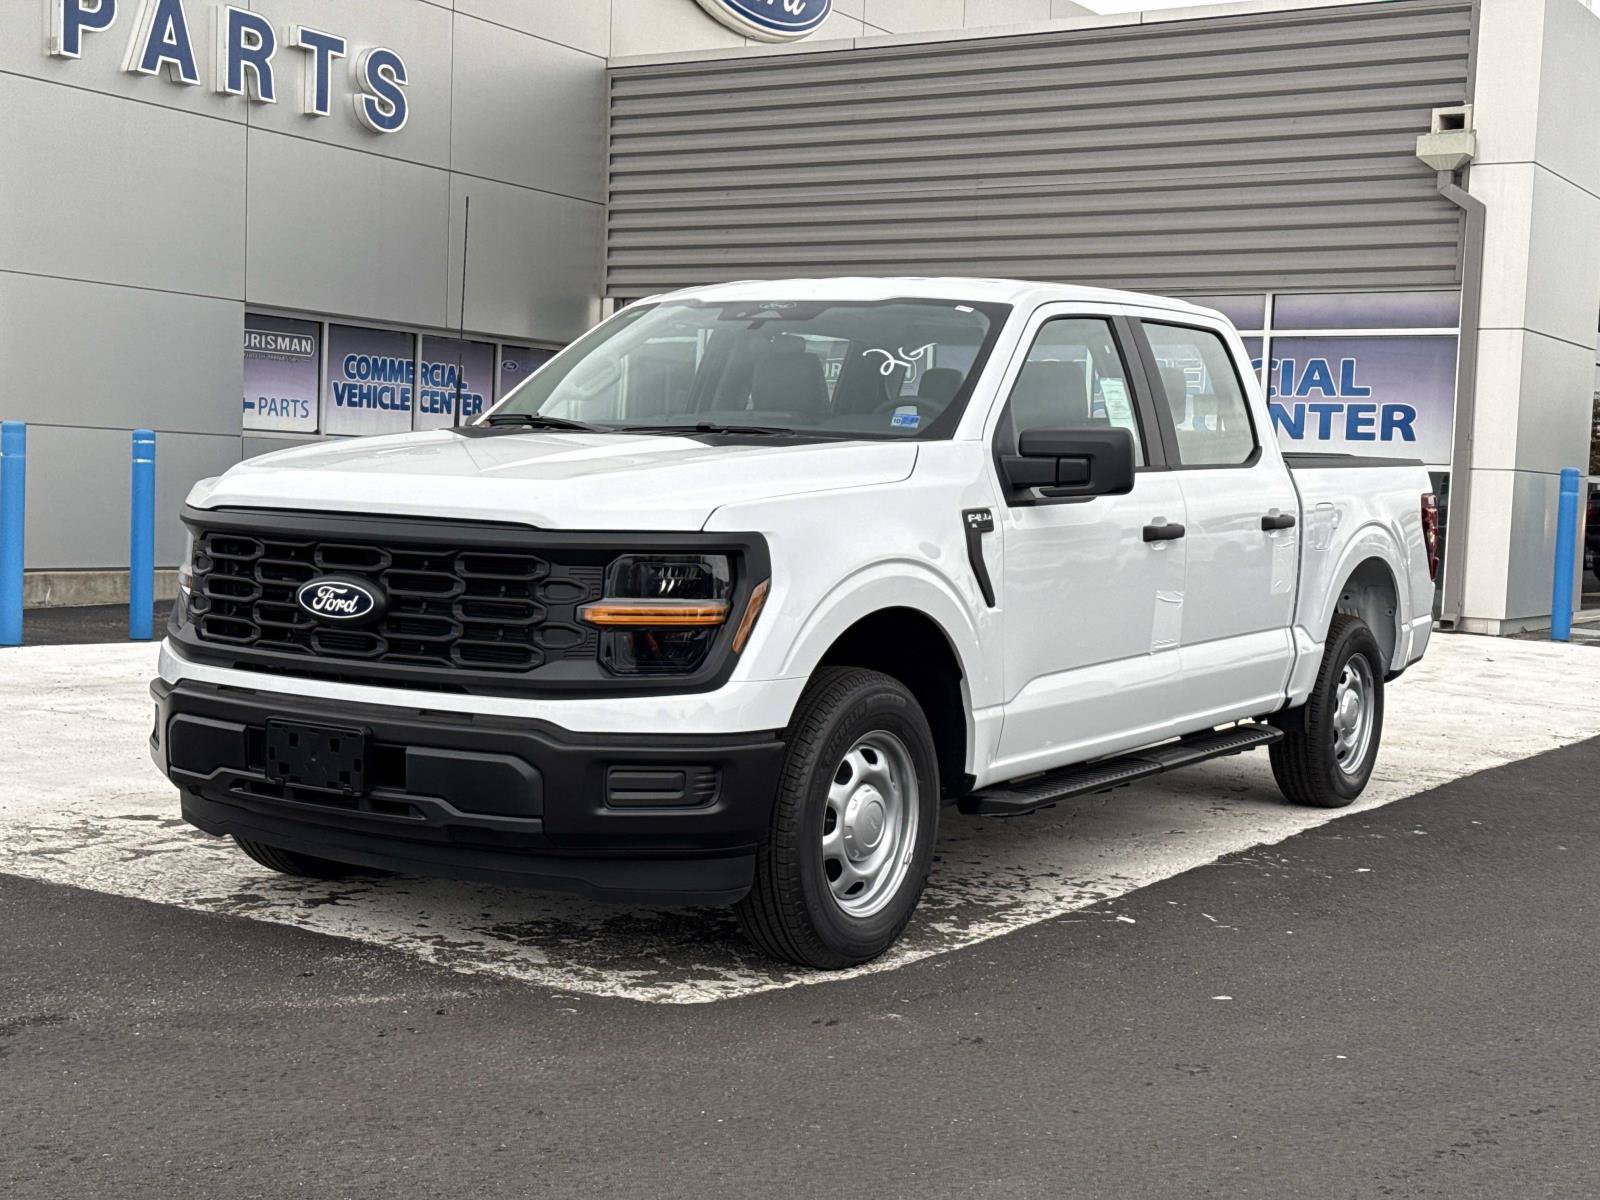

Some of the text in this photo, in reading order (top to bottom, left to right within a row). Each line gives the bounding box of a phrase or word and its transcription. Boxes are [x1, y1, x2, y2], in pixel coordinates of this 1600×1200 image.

[49, 0, 409, 134] PARTS
[343, 353, 469, 391] COMMERCIAL
[258, 396, 310, 419] PARTS
[332, 380, 412, 412] VEHICLE
[312, 585, 359, 613] Ford
